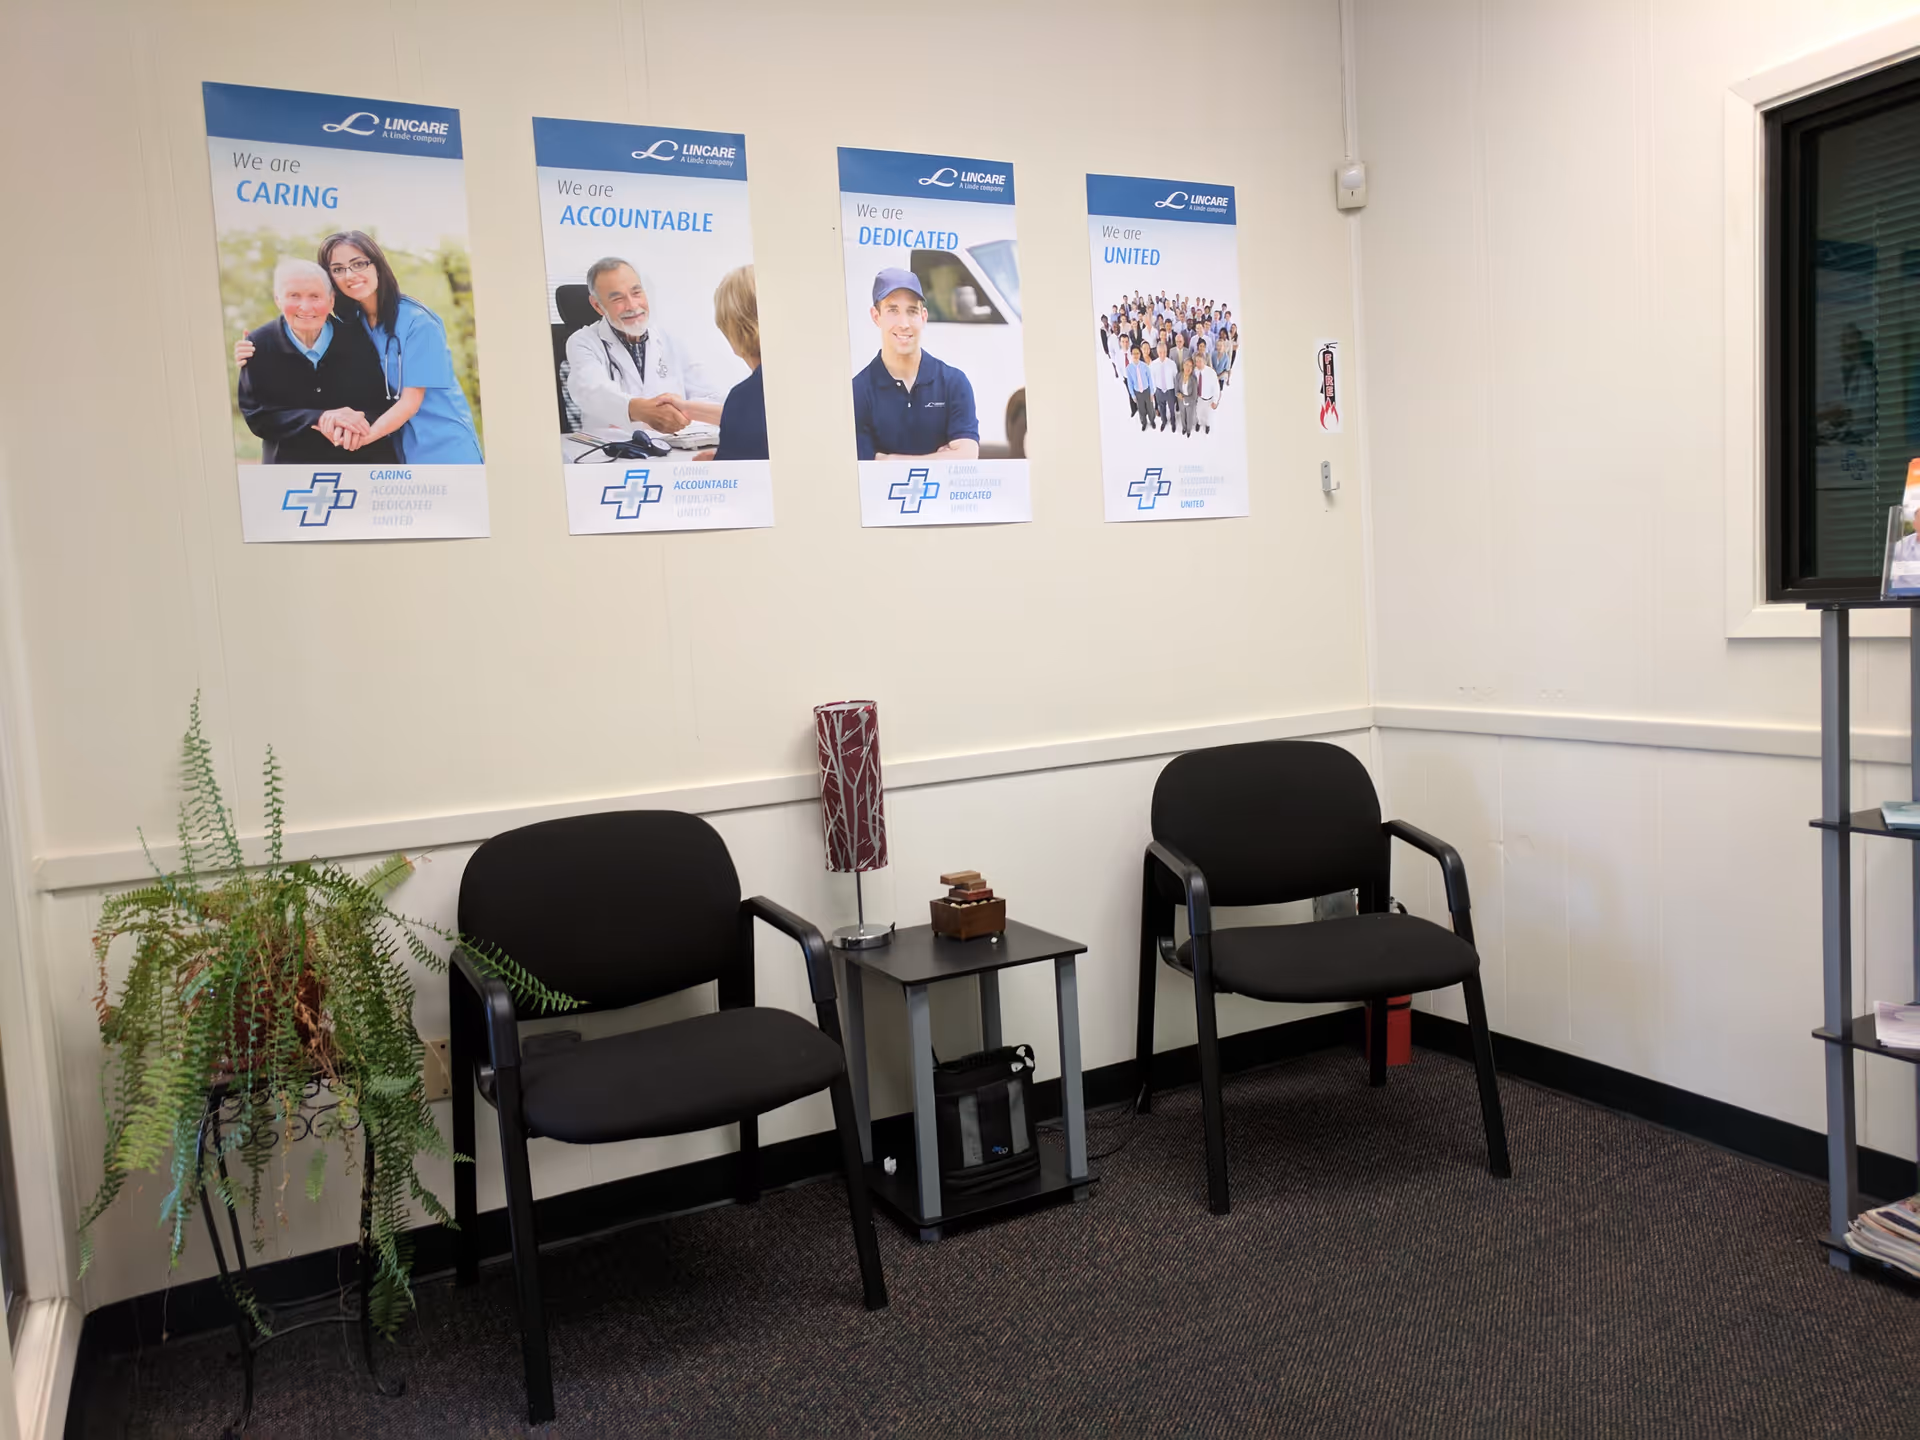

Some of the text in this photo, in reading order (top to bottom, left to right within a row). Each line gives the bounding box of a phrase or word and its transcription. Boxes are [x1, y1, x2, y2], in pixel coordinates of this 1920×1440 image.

[384, 117, 449, 136] LINCARE
[390, 132, 412, 141] Linde
[412, 134, 446, 144] company
[682, 144, 736, 159] LINCARE
[233, 152, 301, 174] We are
[687, 156, 705, 165] Linde
[706, 158, 734, 167] company
[960, 171, 1006, 185] LINCARE
[236, 179, 339, 210] CARING
[558, 180, 614, 198] We are
[980, 184, 1004, 193] company
[1190, 194, 1229, 207] LINCARE
[560, 205, 714, 233] ACCOUNTABLE
[856, 203, 904, 220] We are
[859, 226, 959, 251] DEDICATED
[1102, 225, 1142, 240] We are
[1104, 246, 1161, 266] UNITED
[1325, 354, 1334, 396] FIRE
[370, 470, 412, 480] CARING
[673, 479, 738, 490] ACCOUNTABLE
[950, 490, 992, 500] DEDICATED
[372, 500, 432, 511] DEDICATED
[1180, 500, 1205, 508] UNITED
